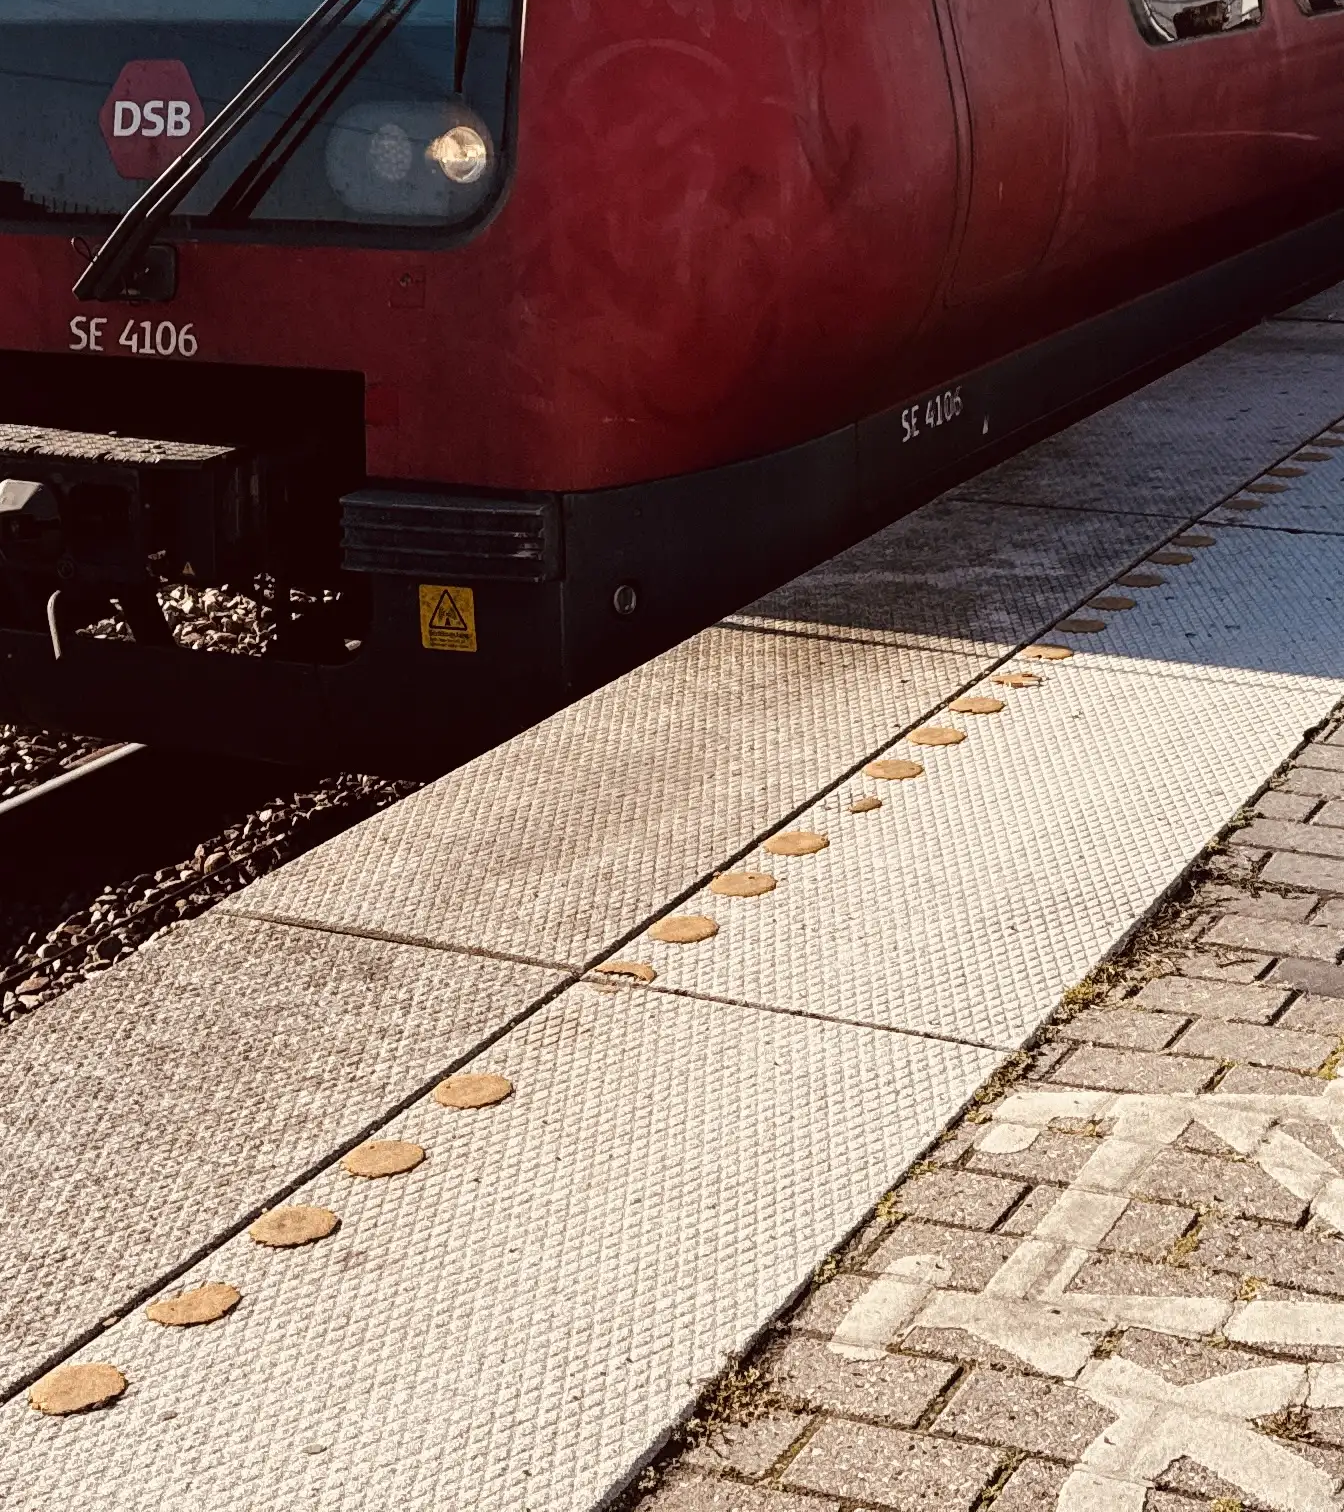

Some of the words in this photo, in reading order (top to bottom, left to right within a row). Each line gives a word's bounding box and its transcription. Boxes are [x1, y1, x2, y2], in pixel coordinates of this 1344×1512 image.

[113, 100, 191, 137] DSB
[69, 316, 107, 351] SE
[119, 319, 198, 357] 4106
[901, 404, 920, 443] SE
[925, 386, 964, 429] 4106
